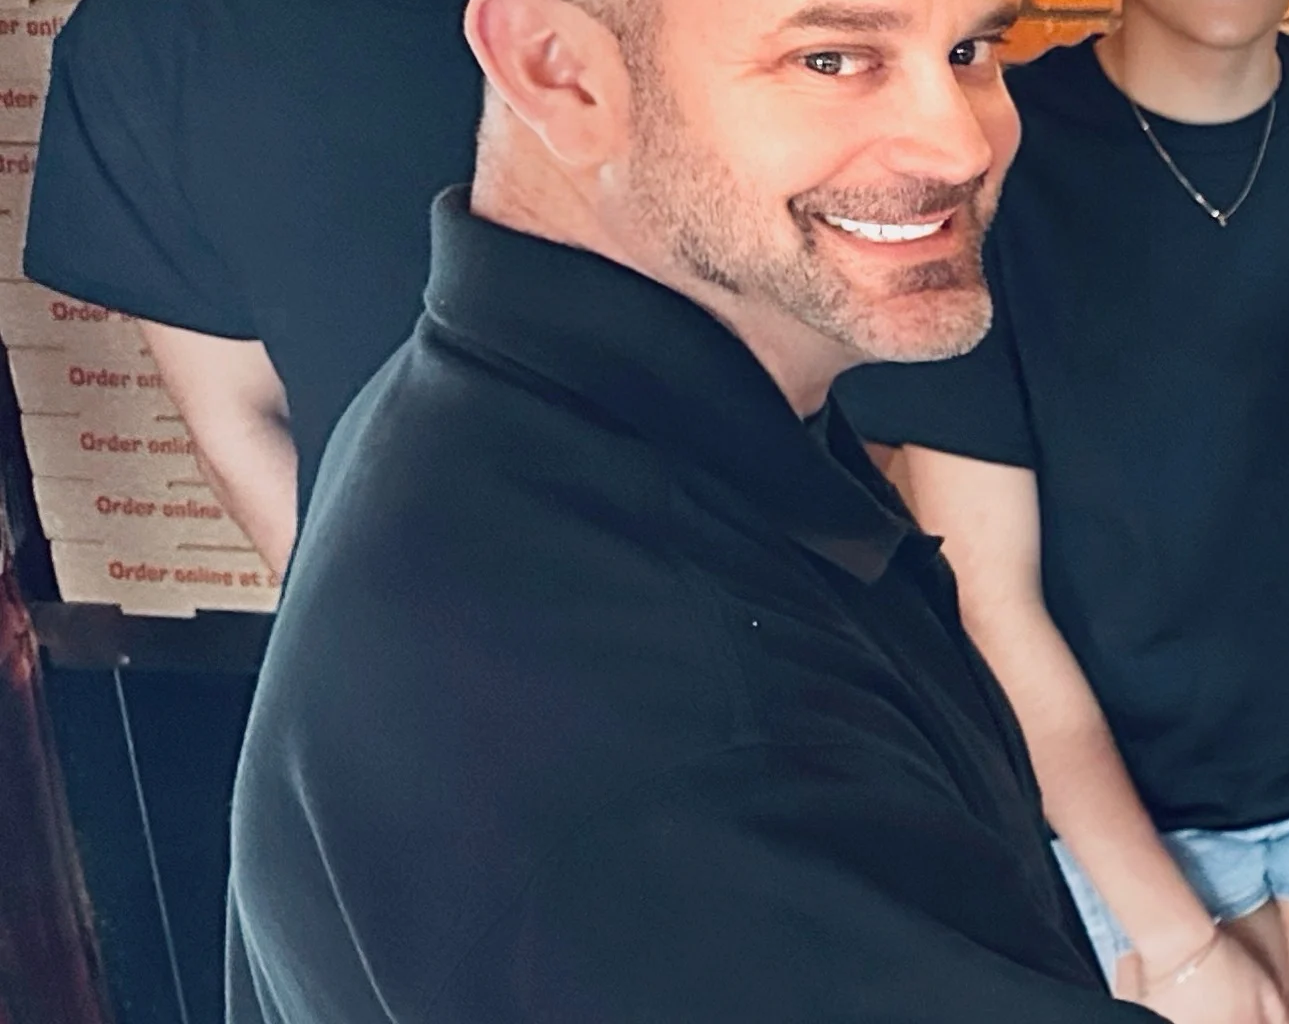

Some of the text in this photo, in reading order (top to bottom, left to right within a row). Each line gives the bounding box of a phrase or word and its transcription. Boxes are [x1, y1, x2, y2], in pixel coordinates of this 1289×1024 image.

[69, 367, 131, 388] Order
[80, 431, 142, 452] Order
[96, 495, 223, 520] Order online
[108, 561, 168, 582] Order
[239, 572, 261, 587] at
